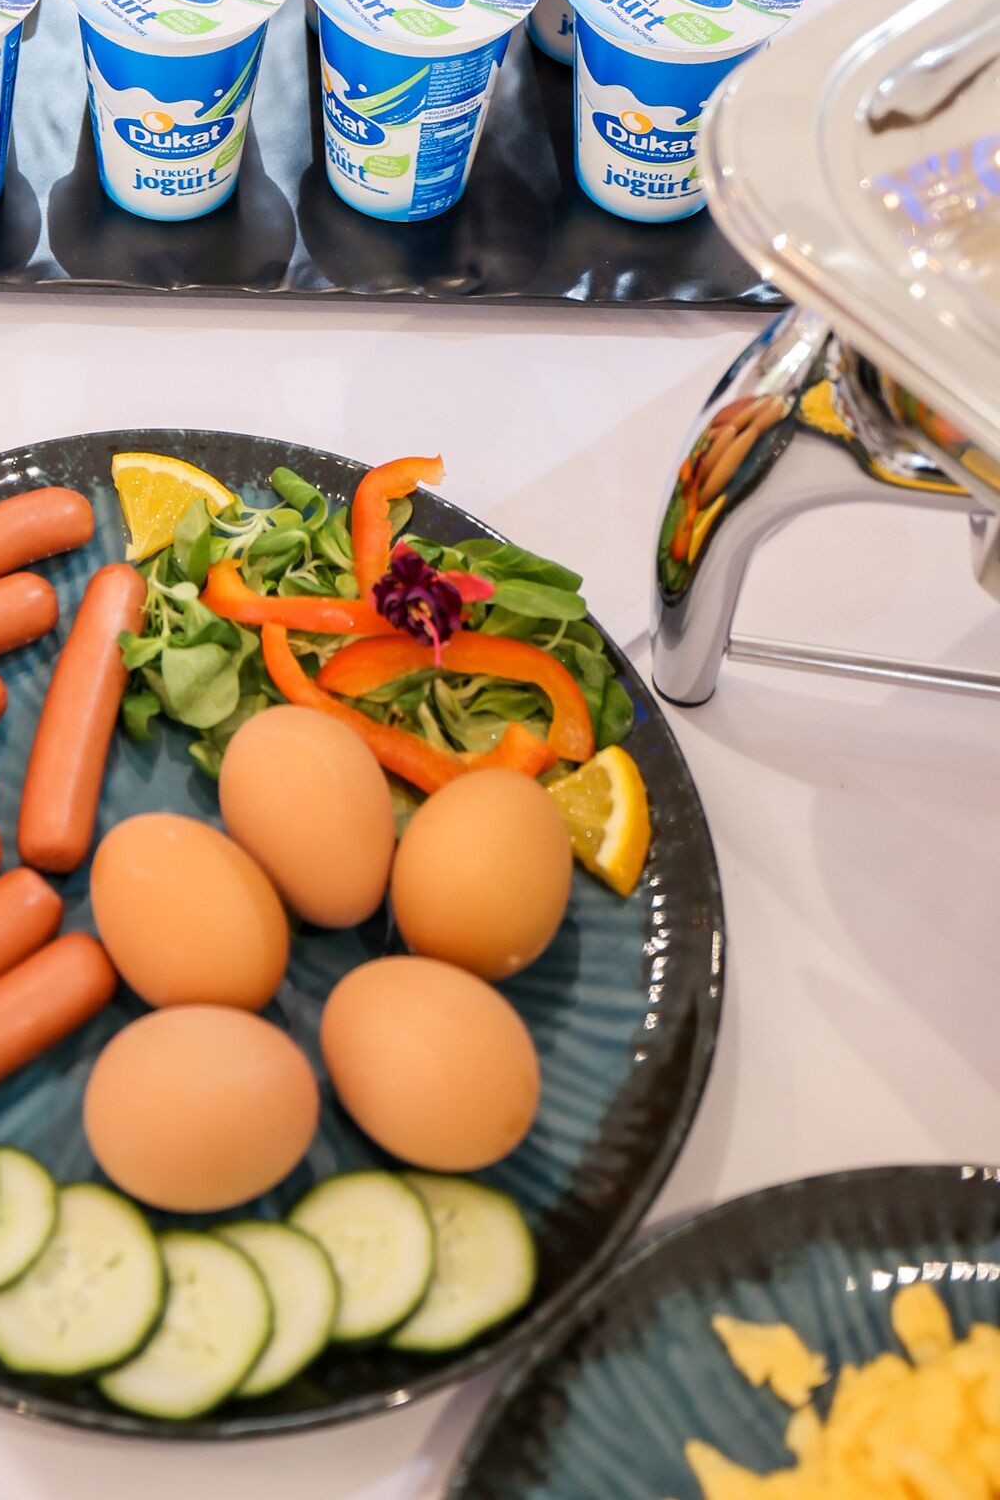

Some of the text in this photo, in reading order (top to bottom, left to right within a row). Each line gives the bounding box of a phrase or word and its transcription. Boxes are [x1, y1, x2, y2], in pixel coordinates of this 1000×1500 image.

[630, 23, 658, 45] YOGHURT
[322, 94, 369, 140] ukat
[128, 124, 221, 150] Dukat
[606, 120, 699, 153] Dukat
[133, 167, 217, 197] jogurt
[154, 167, 200, 178] TEKUĆI
[602, 164, 692, 197] jogurt
[624, 166, 673, 181] TEKUĆI
